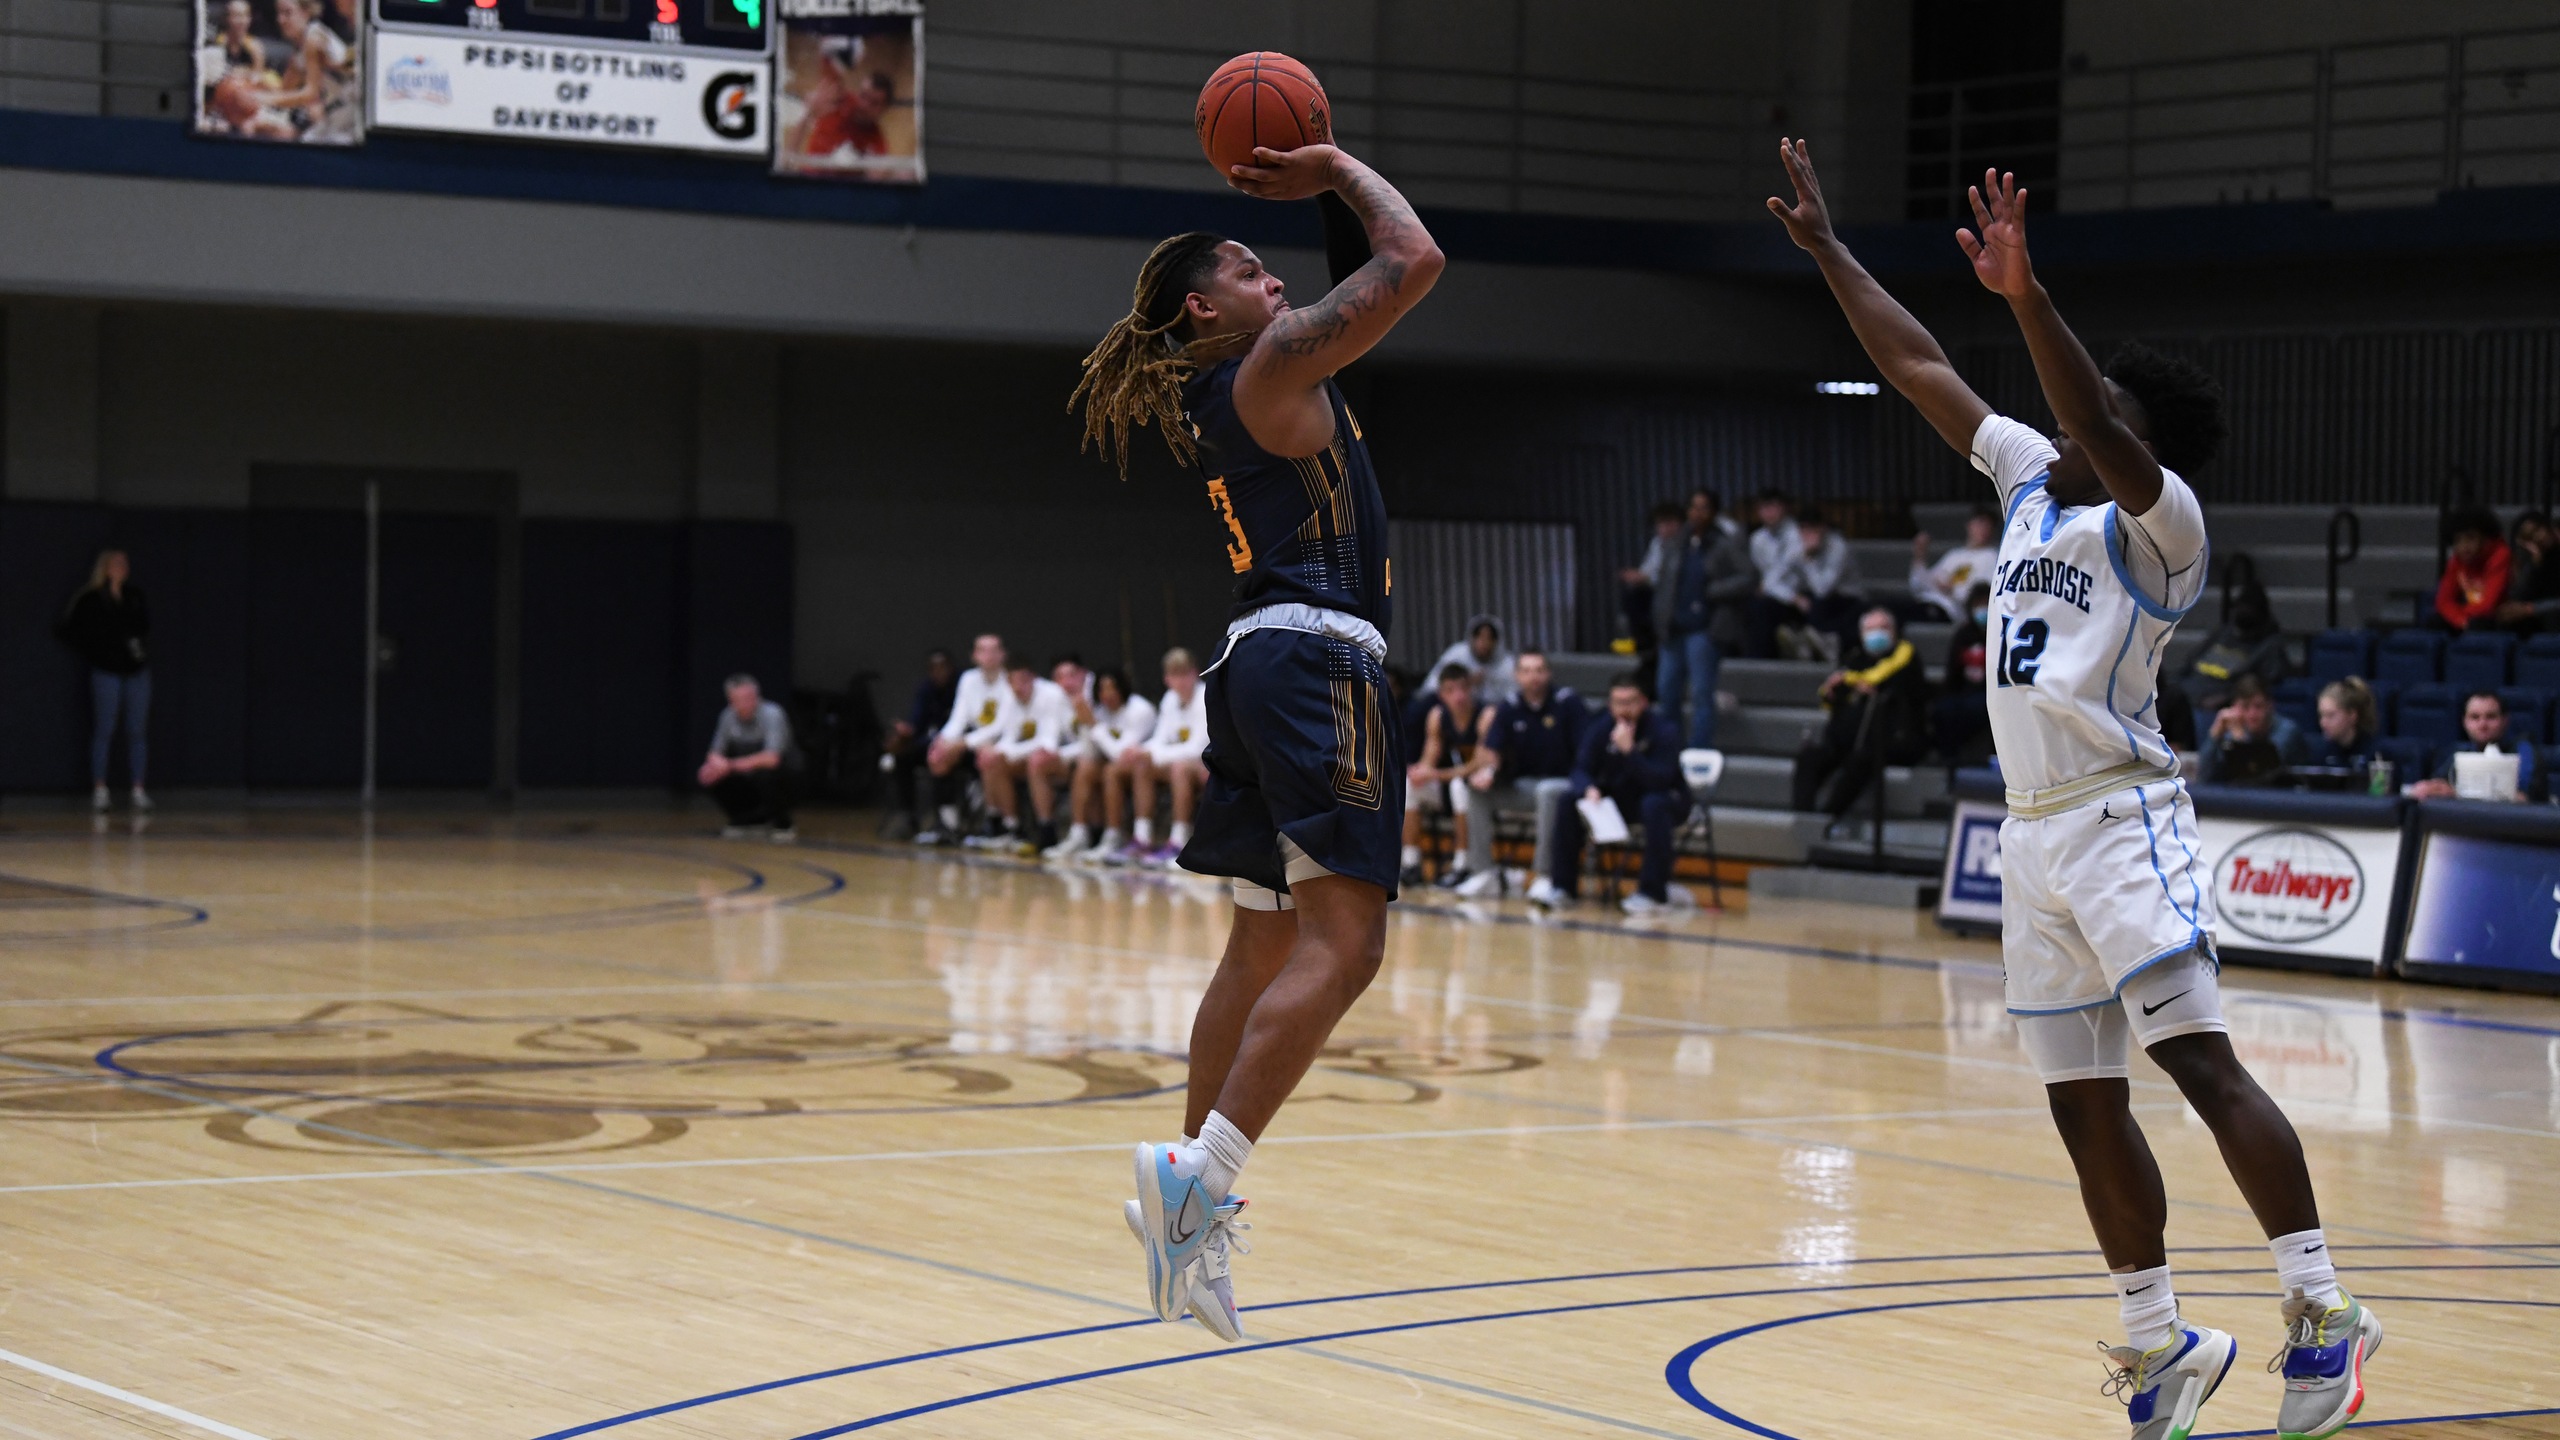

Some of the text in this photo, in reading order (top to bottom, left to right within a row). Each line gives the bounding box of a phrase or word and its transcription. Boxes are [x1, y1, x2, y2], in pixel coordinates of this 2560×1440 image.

[465, 45, 686, 82] PEPSI BOTTLING
[556, 80, 591, 104] OF
[702, 72, 757, 140] G
[493, 106, 658, 136] DAVENPORT
[1996, 613, 2050, 688] 12
[2230, 856, 2354, 913] Trailways
